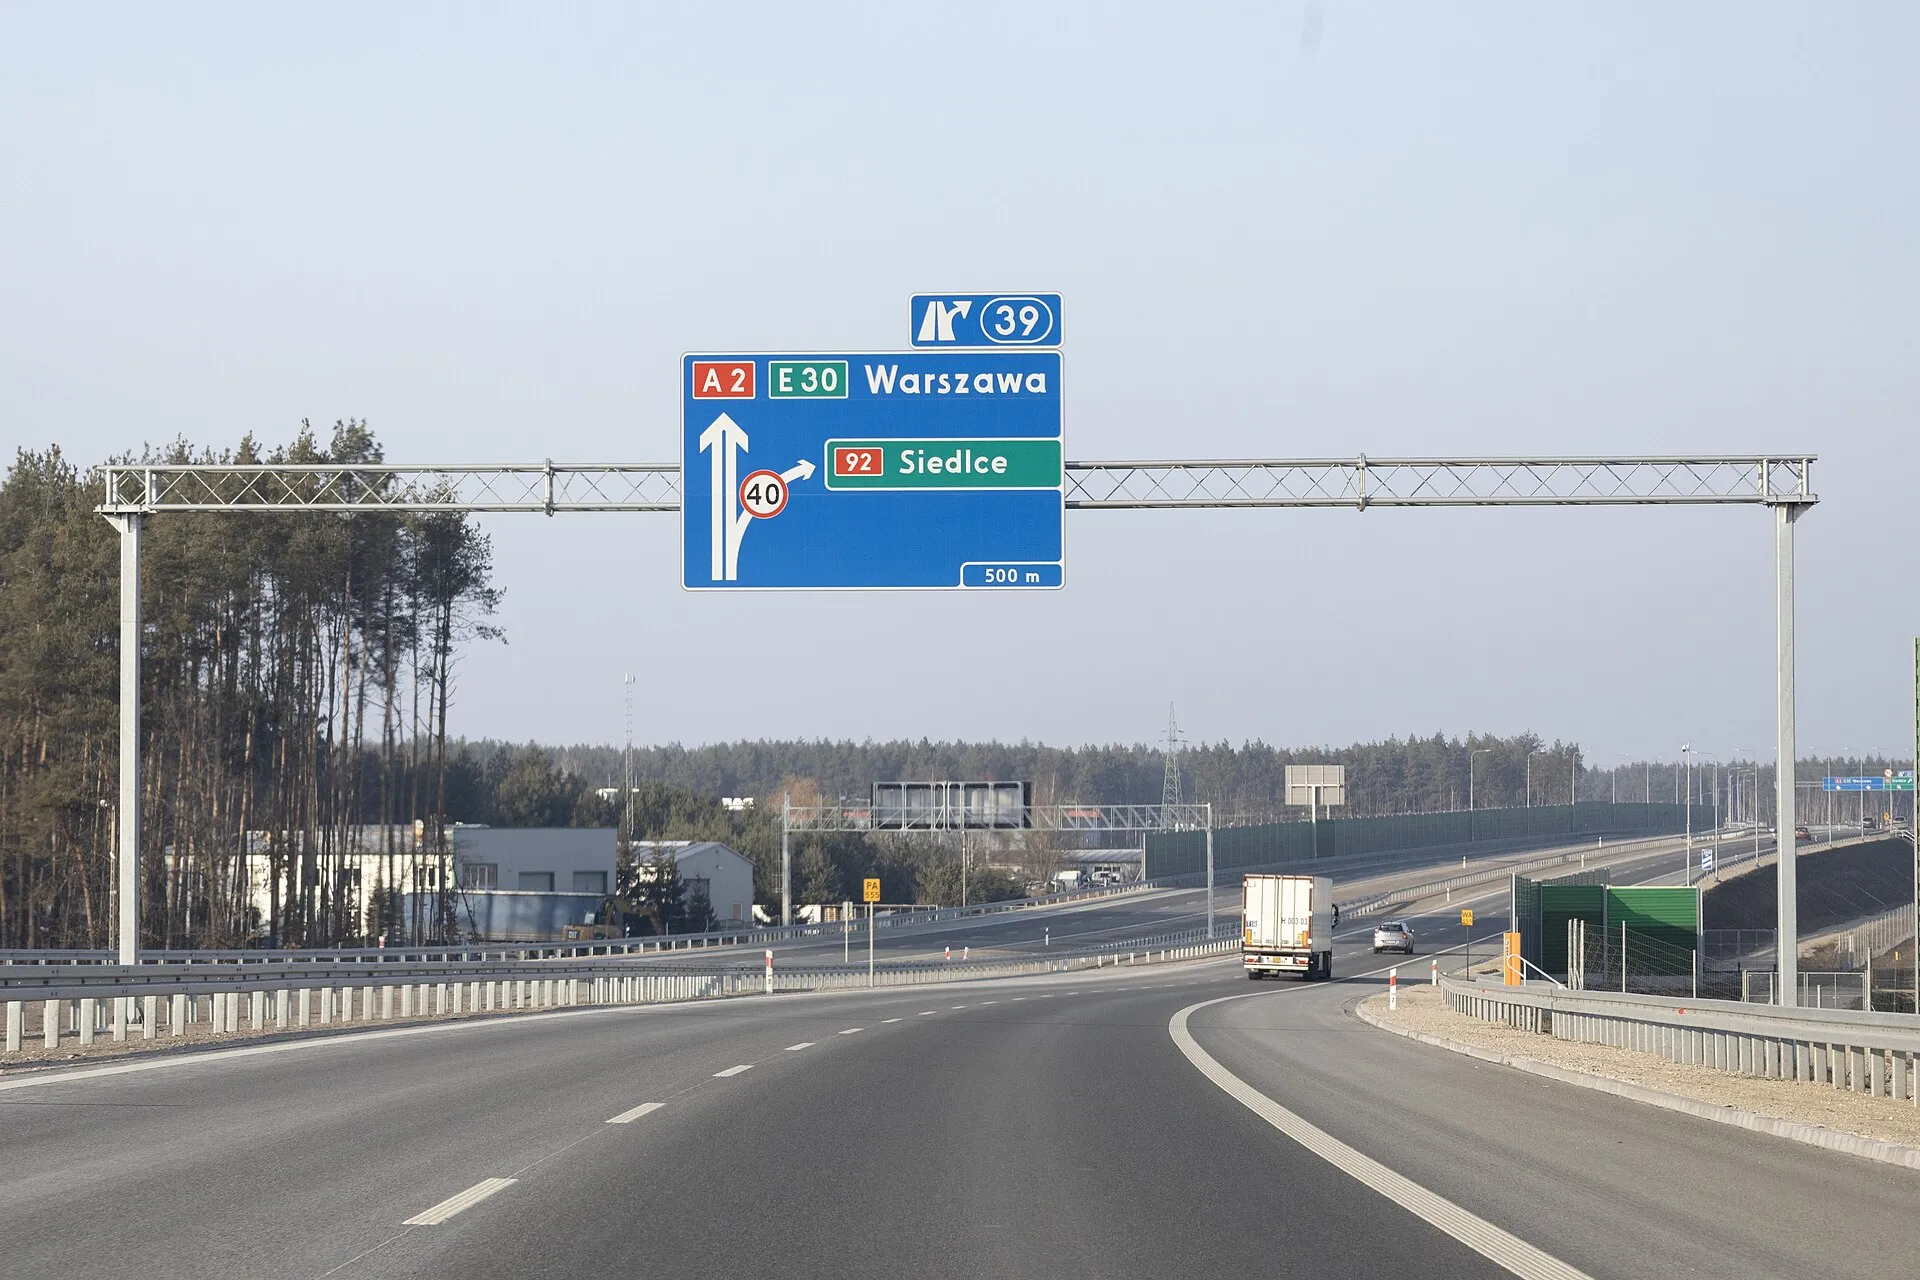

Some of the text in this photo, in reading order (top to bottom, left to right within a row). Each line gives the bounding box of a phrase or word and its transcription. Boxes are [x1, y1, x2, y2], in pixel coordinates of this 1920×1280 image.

[994, 305, 1040, 336] 39
[702, 369, 746, 393] A 2
[779, 368, 838, 392] E 30
[864, 364, 1047, 395] Warszawa
[845, 453, 872, 472] 92
[899, 449, 1008, 475] Siedlce
[746, 483, 780, 506] 40
[985, 568, 1040, 583] 500 m
[866, 882, 878, 890] PA
